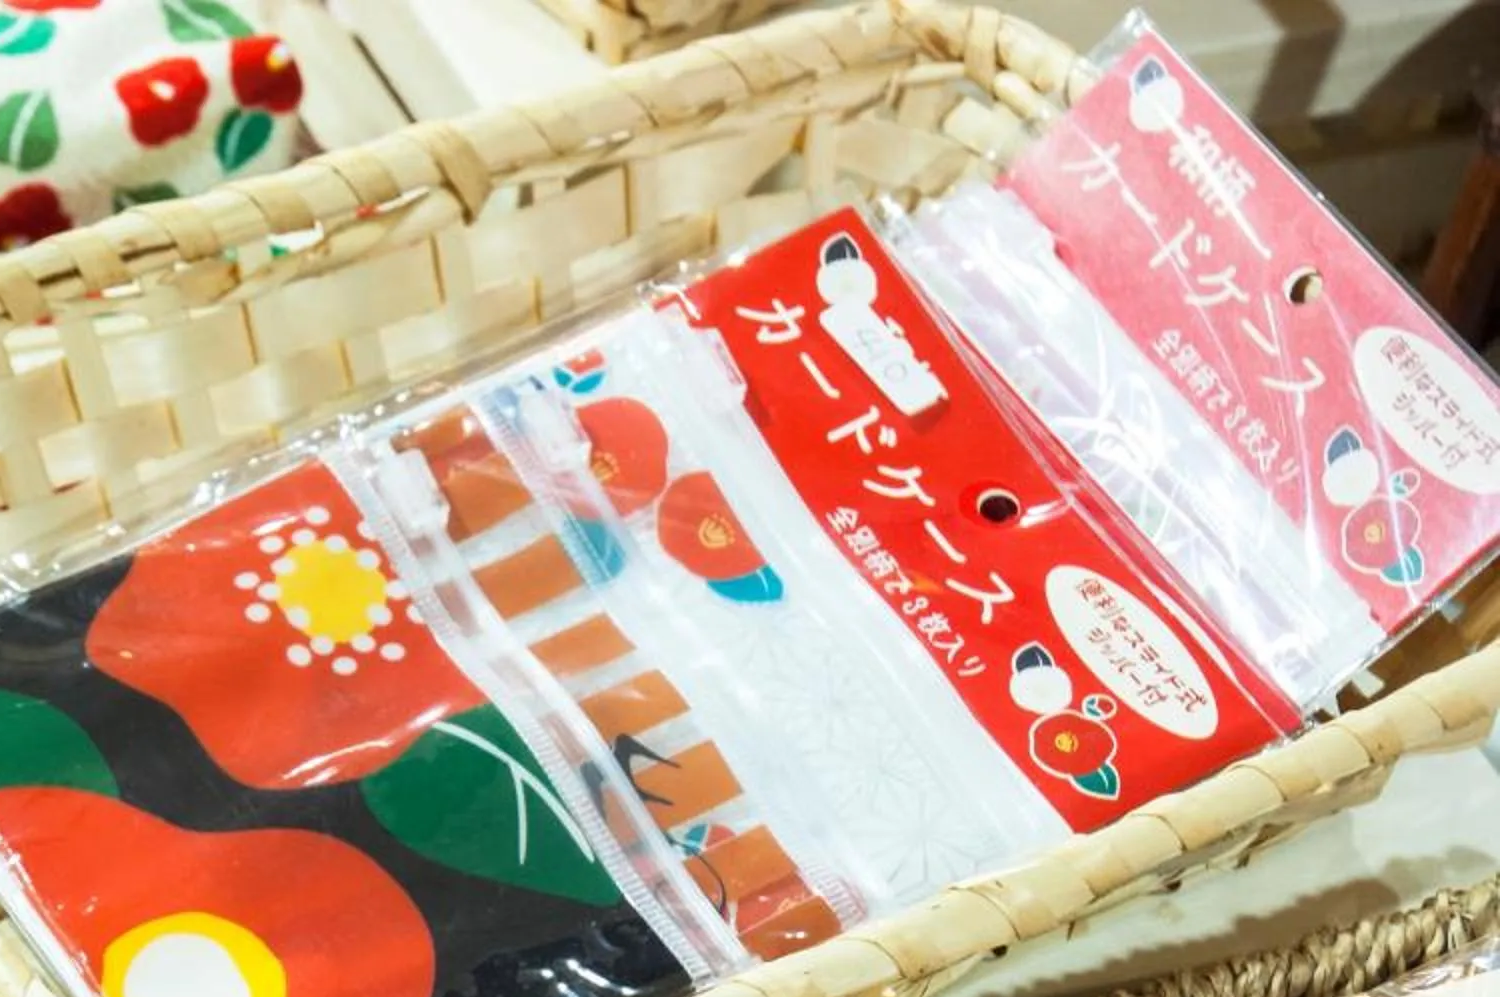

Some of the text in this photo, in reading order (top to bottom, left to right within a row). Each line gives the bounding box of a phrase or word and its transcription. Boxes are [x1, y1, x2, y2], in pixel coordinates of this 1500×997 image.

[1060, 142, 1326, 418] カードケース
[735, 298, 1015, 625] カードケース
[826, 504, 986, 678] 全別柄で3枚入り
[1074, 577, 1208, 714] 便利なスライド式
[1086, 626, 1169, 707] ジッパー付
